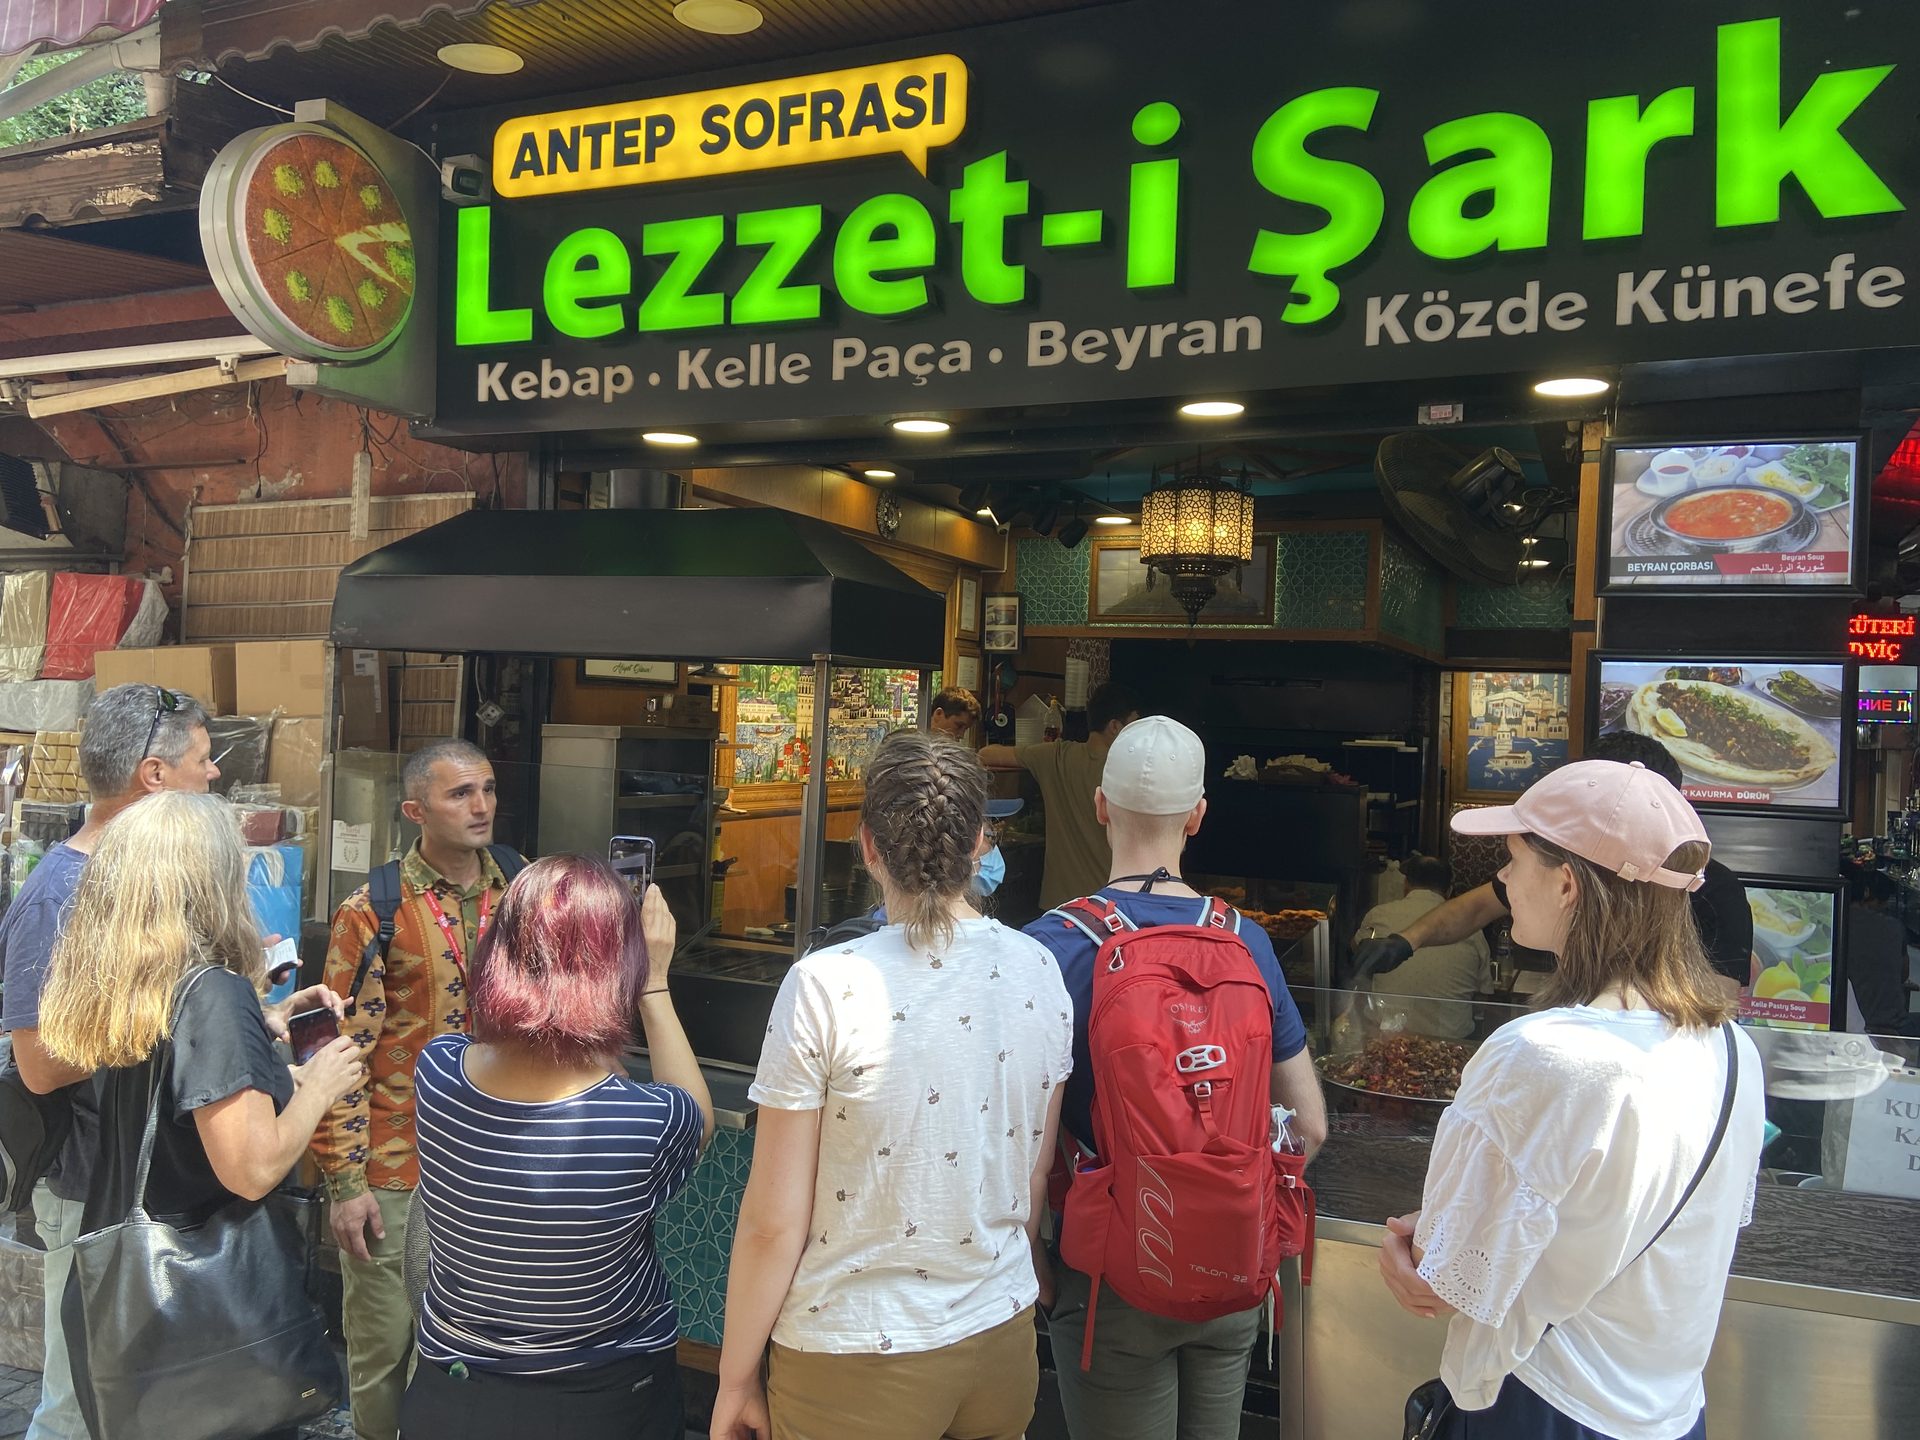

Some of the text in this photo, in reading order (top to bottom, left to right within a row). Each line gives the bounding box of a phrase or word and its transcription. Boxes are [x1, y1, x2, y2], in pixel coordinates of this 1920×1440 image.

[509, 72, 948, 180] ANTEP SOFRASI
[456, 17, 1906, 346] Lezzet-i Şark
[477, 252, 1905, 403] Kebap Kelle Paça Beyran Közde Künefe
[1781, 553, 1825, 563] Beyran Soup
[1627, 561, 1714, 574] BEYRAN ÇORBASI
[1689, 789, 1733, 799] KAVURMA
[1736, 790, 1770, 800] DÜRÜM
[1768, 1001, 1790, 1012] Pastry
[1790, 1003, 1807, 1013] Soup
[1232, 1274, 1248, 1283] 22
